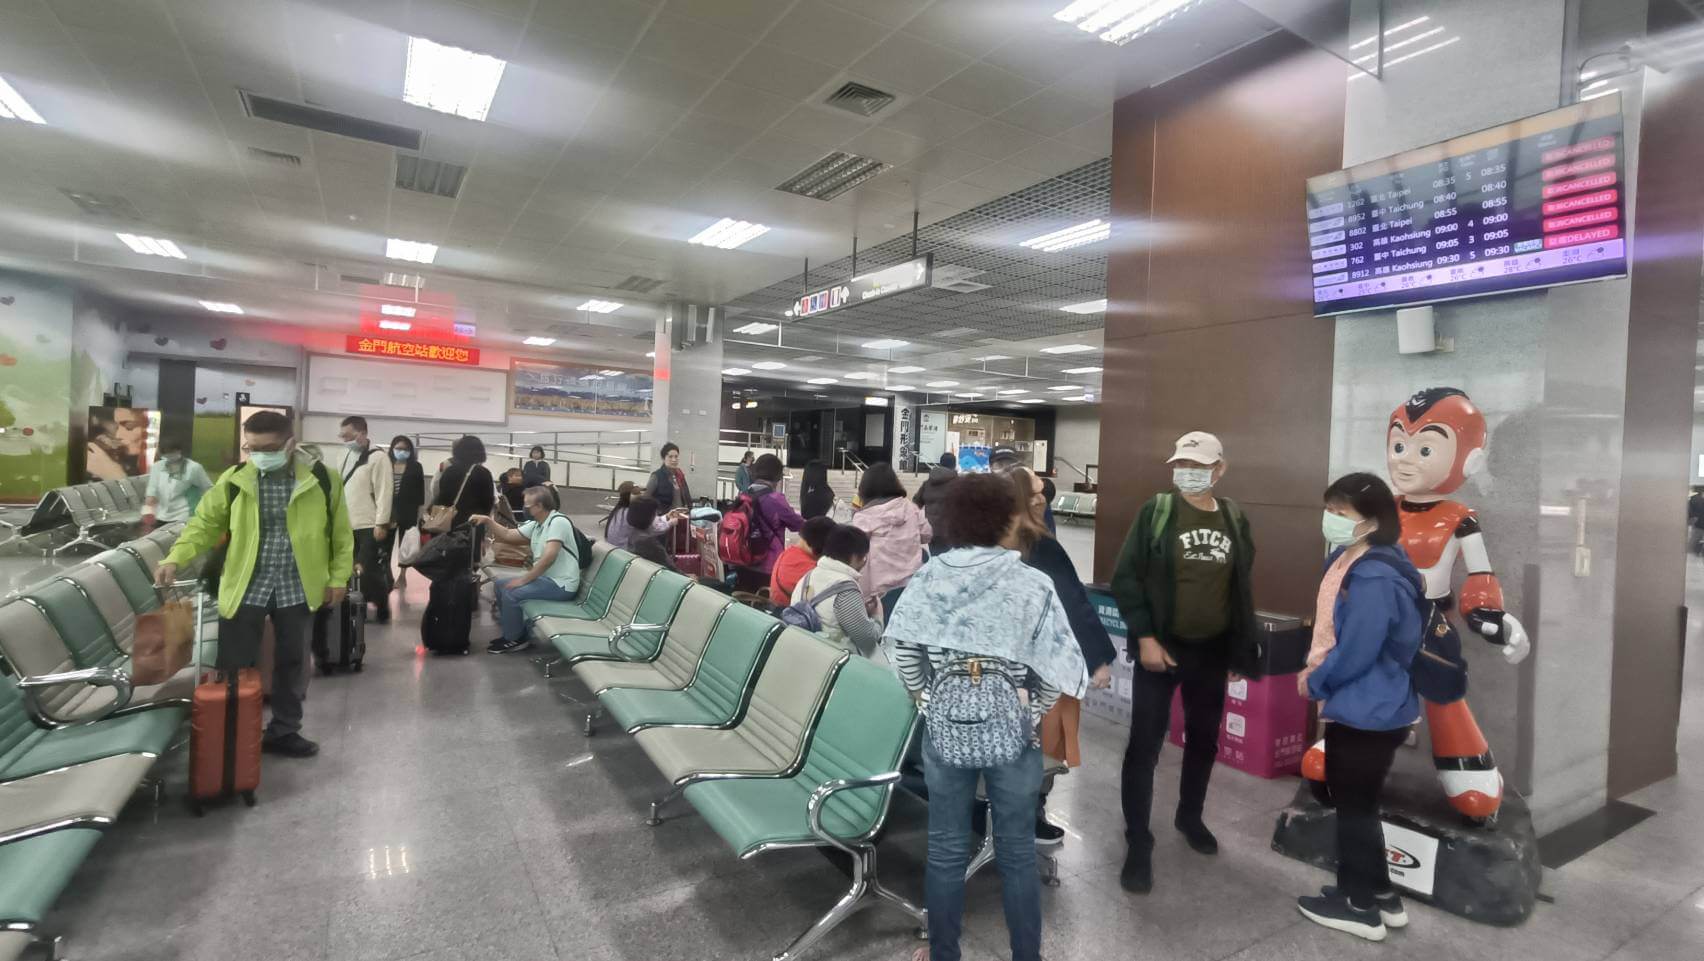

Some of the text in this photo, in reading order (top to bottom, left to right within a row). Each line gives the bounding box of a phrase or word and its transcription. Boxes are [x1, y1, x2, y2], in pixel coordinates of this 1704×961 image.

[1388, 188, 1411, 199] Taipei
[1433, 176, 1456, 188] 08:35
[1481, 164, 1506, 177] 08:35
[1389, 201, 1424, 213] Taichung
[1433, 192, 1456, 204] 08:40
[1481, 180, 1507, 193] 08:40
[1389, 217, 1413, 229] Taipei
[1434, 208, 1457, 219] 08:55
[1482, 196, 1507, 209] 08:55
[1350, 242, 1364, 251] 302
[1390, 229, 1432, 243] Kaohsiung
[1435, 223, 1458, 234] 09:00
[1467, 220, 1474, 228] 4
[1483, 213, 1508, 225] 09:00
[1351, 256, 1365, 265] 762
[1391, 246, 1427, 258] Taichung
[1436, 238, 1459, 250] 09:05
[1468, 235, 1475, 244] 3
[1483, 229, 1509, 241] 09:05
[1351, 269, 1370, 279] 8912
[1392, 260, 1433, 272] Kaohsiung
[1437, 254, 1460, 265] 09:30
[1484, 245, 1510, 257] 09:30
[358, 338, 469, 362] 金門航空站歡迎您
[1179, 528, 1232, 553] FITCH
